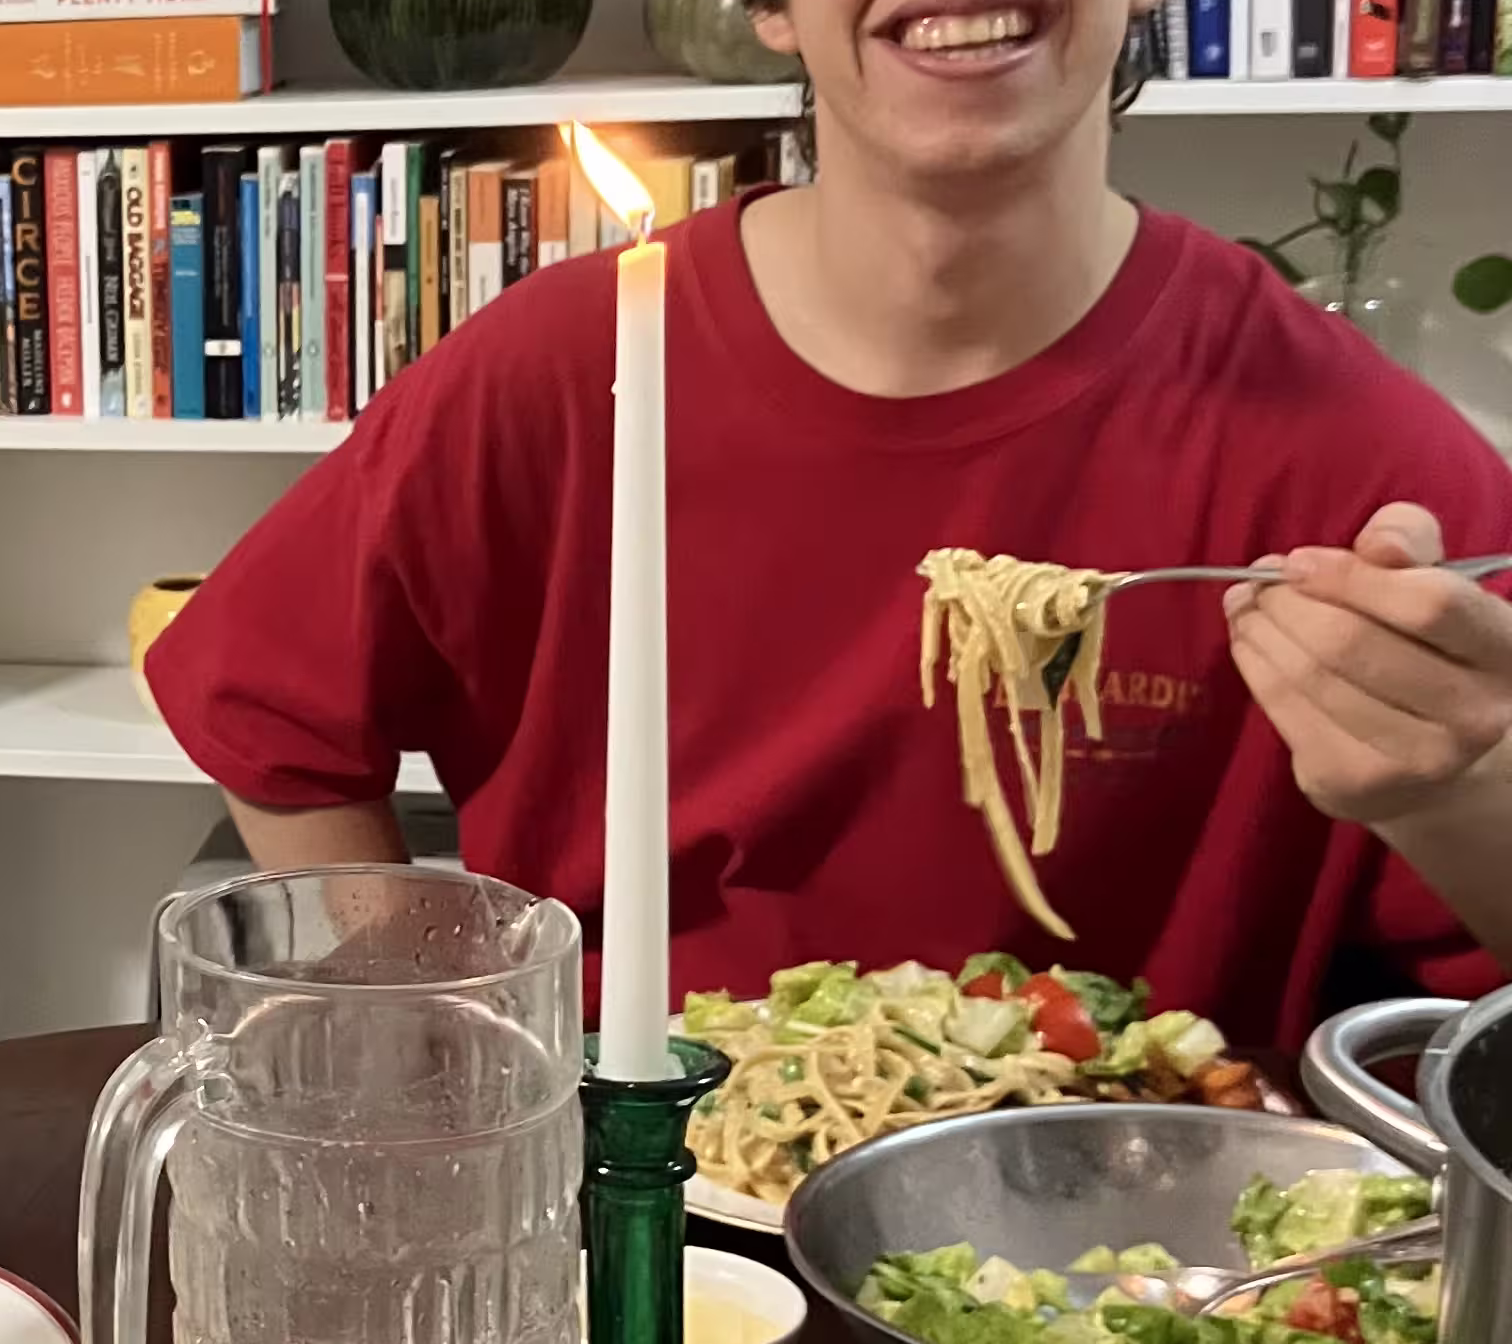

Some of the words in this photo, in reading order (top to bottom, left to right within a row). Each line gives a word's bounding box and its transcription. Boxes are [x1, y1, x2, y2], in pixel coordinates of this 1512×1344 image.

[11, 156, 41, 321] CIRCE
[127, 186, 145, 228] OLD
[128, 233, 145, 321] BAGGAGE
